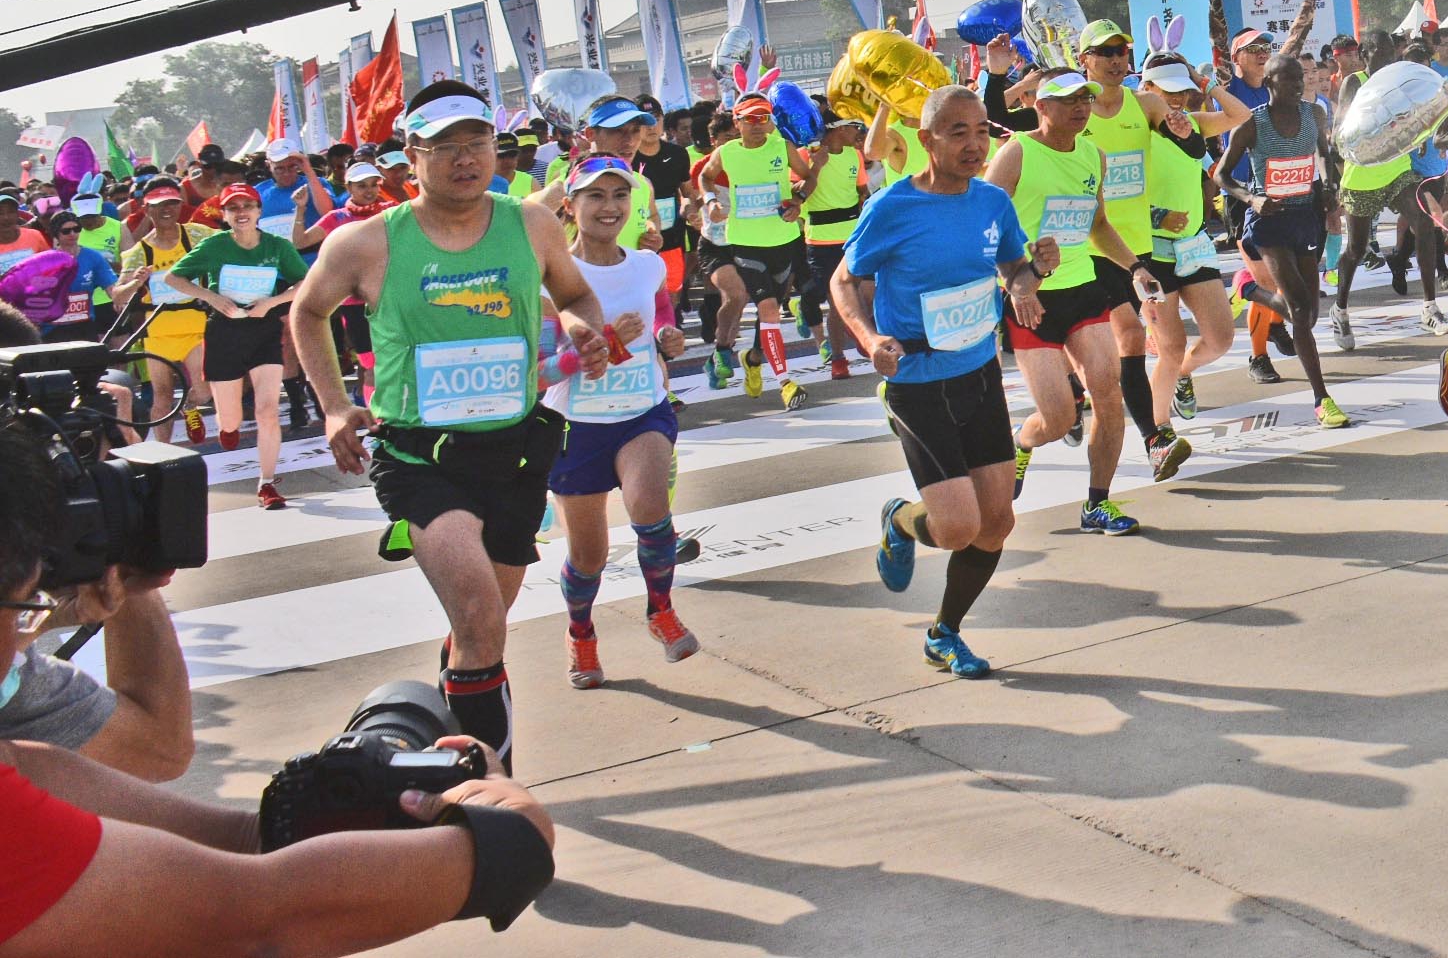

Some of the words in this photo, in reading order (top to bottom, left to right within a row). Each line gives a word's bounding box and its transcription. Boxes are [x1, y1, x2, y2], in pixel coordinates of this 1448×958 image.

[1267, 20, 1295, 33] 赛事
[1105, 166, 1141, 183] 1218
[1270, 167, 1311, 184] C2215
[738, 193, 776, 207] A1044
[933, 293, 993, 333] A0277
[427, 363, 521, 396] A0096
[702, 516, 864, 555] ENTER
